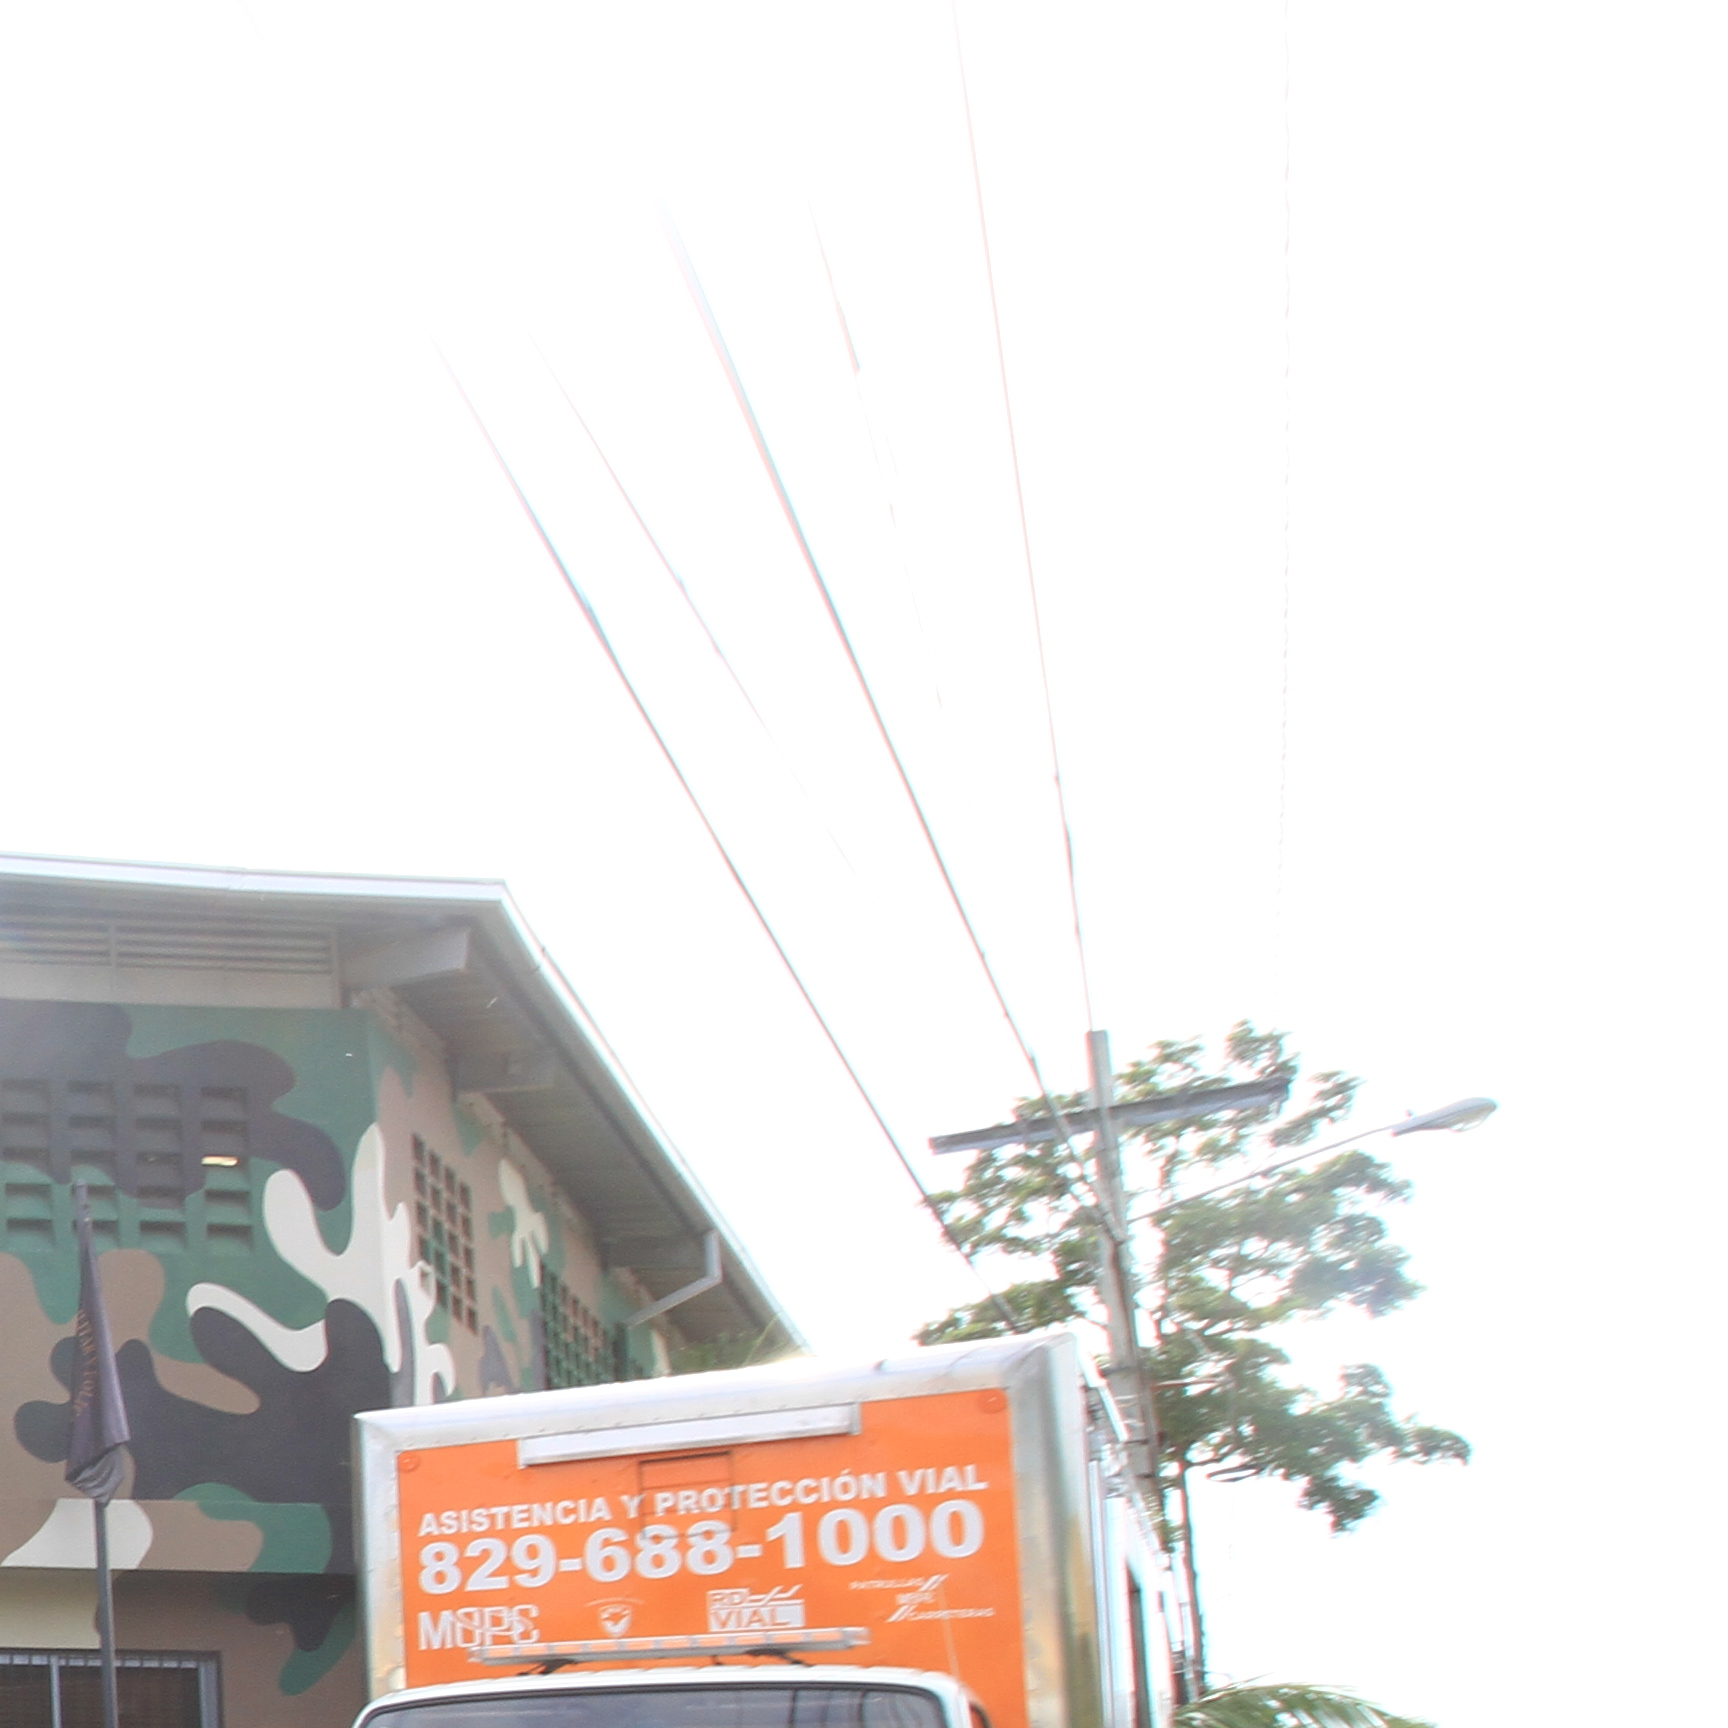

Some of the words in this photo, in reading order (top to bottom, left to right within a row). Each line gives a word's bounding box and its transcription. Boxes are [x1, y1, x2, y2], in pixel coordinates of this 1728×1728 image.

[417, 1497, 613, 1537] ASISTENCIA
[620, 1493, 646, 1519] Y
[653, 1469, 887, 1517] PROTECCIÓN
[896, 1464, 990, 1497] VIAL
[418, 1499, 985, 1595] 829-688-1000
[417, 1603, 541, 1650] MOPC
[709, 1607, 791, 1631] VIAL
